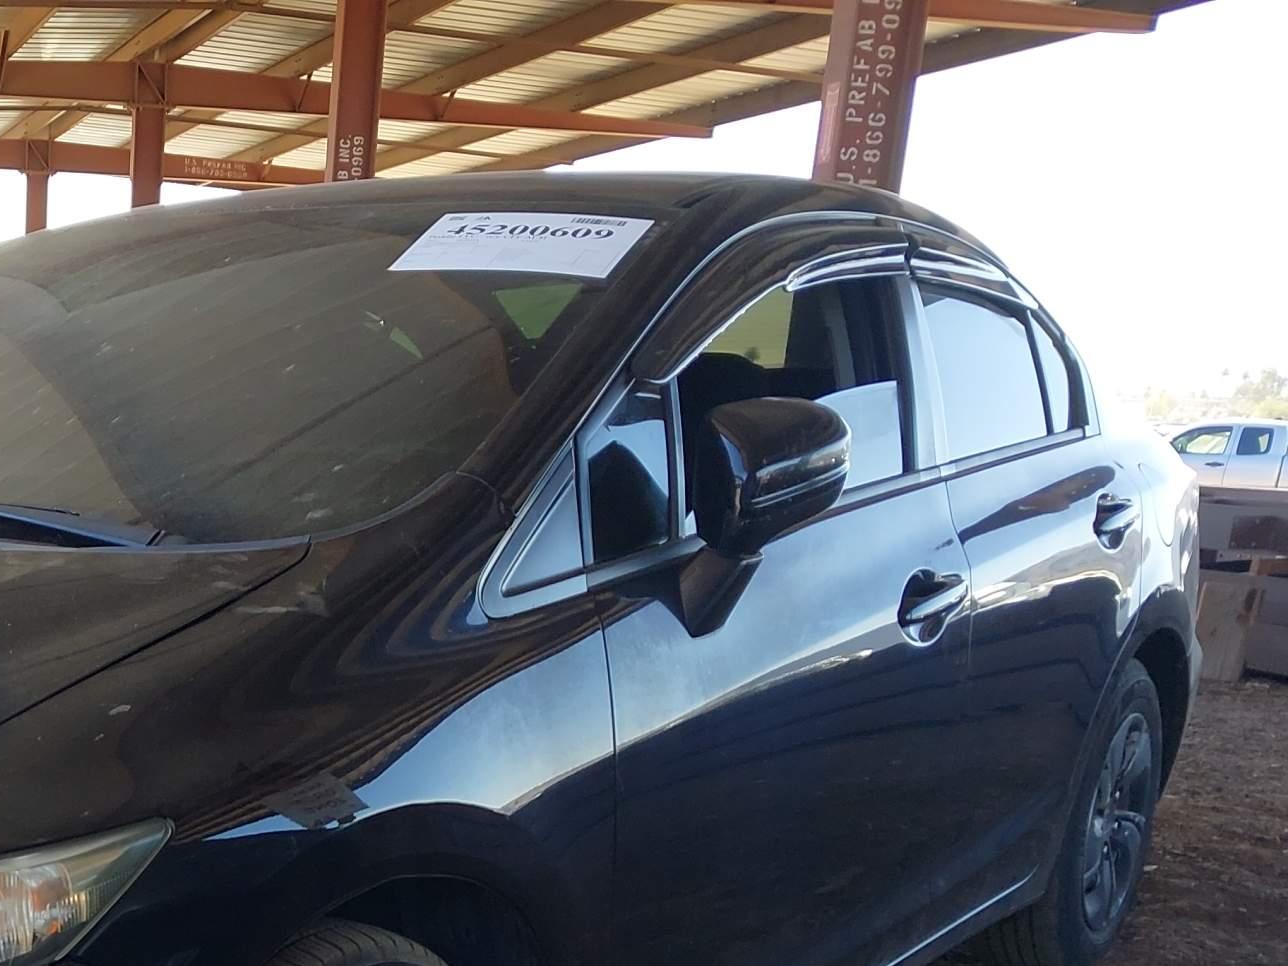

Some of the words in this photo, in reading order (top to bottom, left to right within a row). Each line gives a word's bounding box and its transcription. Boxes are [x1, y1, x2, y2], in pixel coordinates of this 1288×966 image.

[845, 19, 876, 122] PREFAB
[339, 134, 352, 162] INC.
[447, 224, 614, 239] 45200609
